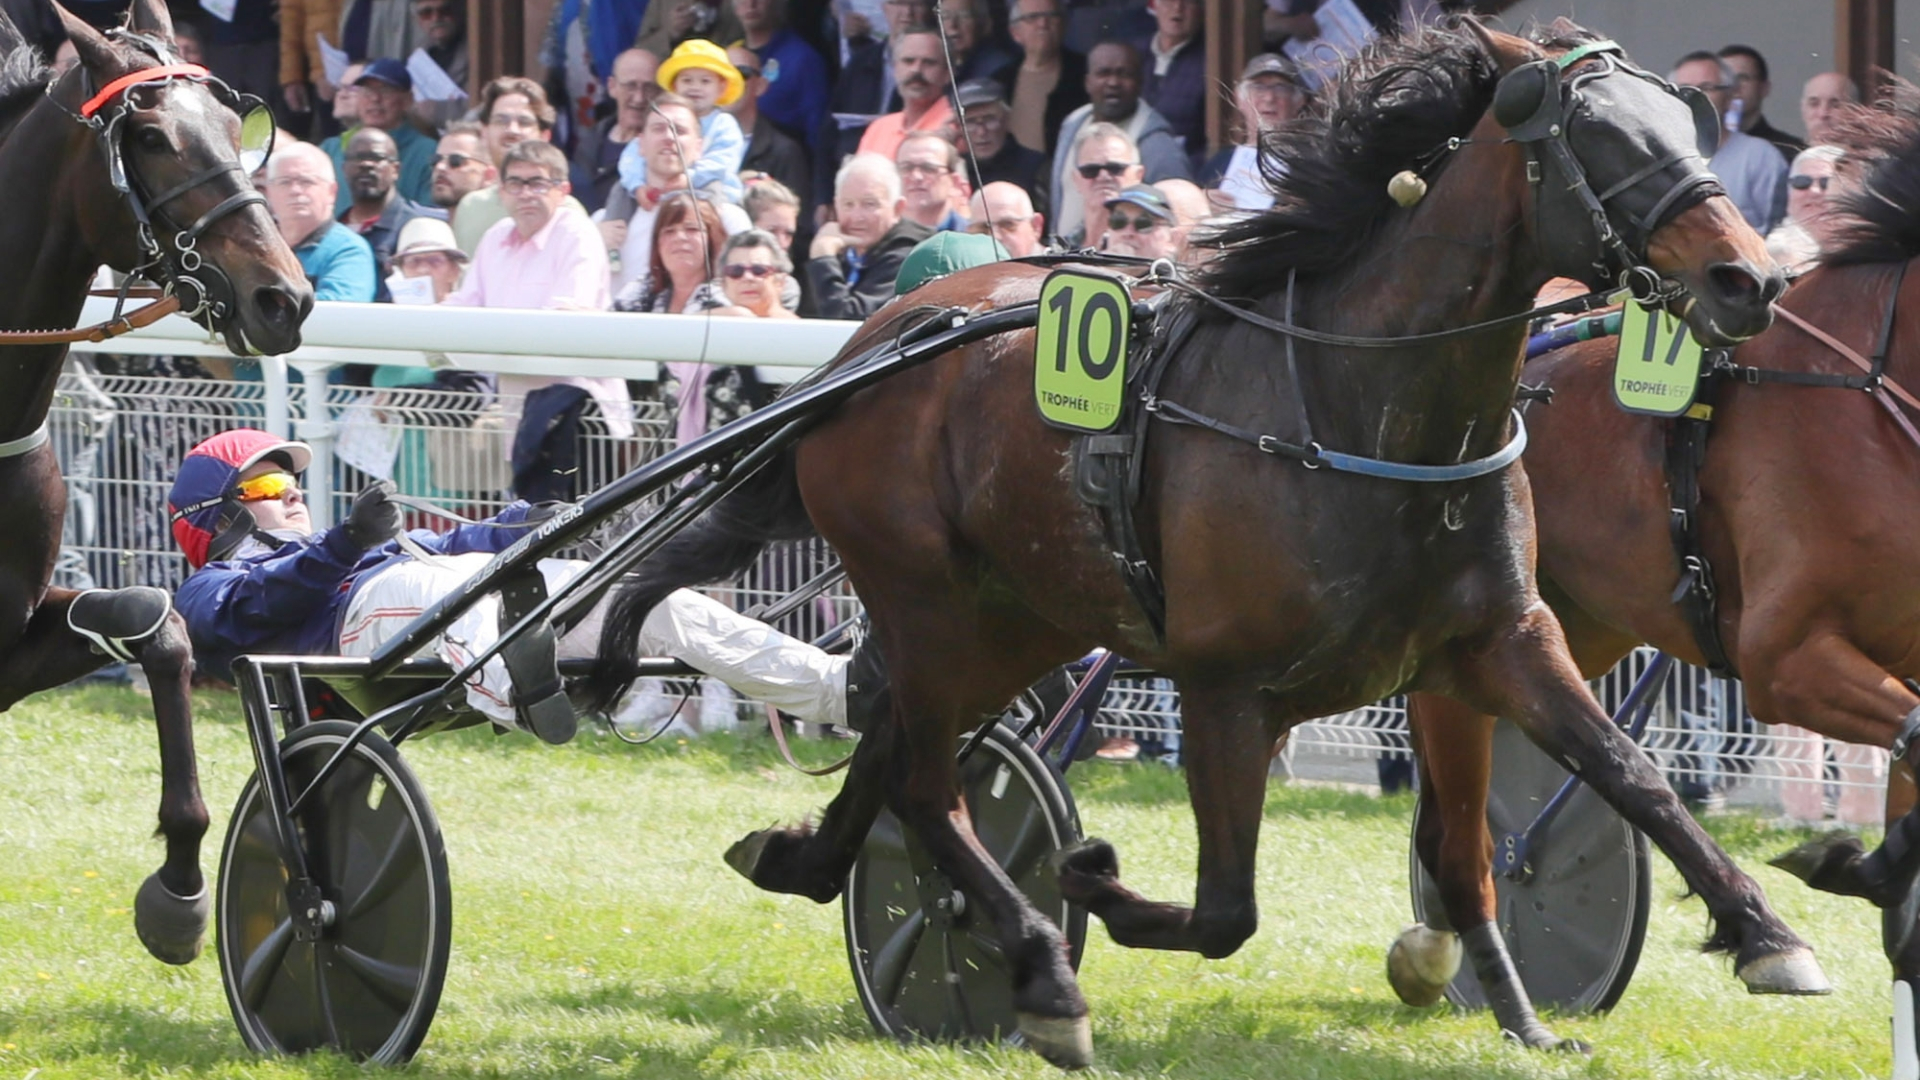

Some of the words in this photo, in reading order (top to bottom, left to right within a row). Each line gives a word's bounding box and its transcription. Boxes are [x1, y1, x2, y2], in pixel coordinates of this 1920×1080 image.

[1048, 285, 1122, 381] 10
[1041, 390, 1089, 412] TROPHÉE
[1090, 401, 1117, 416] VERT
[1620, 379, 1667, 397] TROPHÉE
[537, 502, 585, 540] YONKERS
